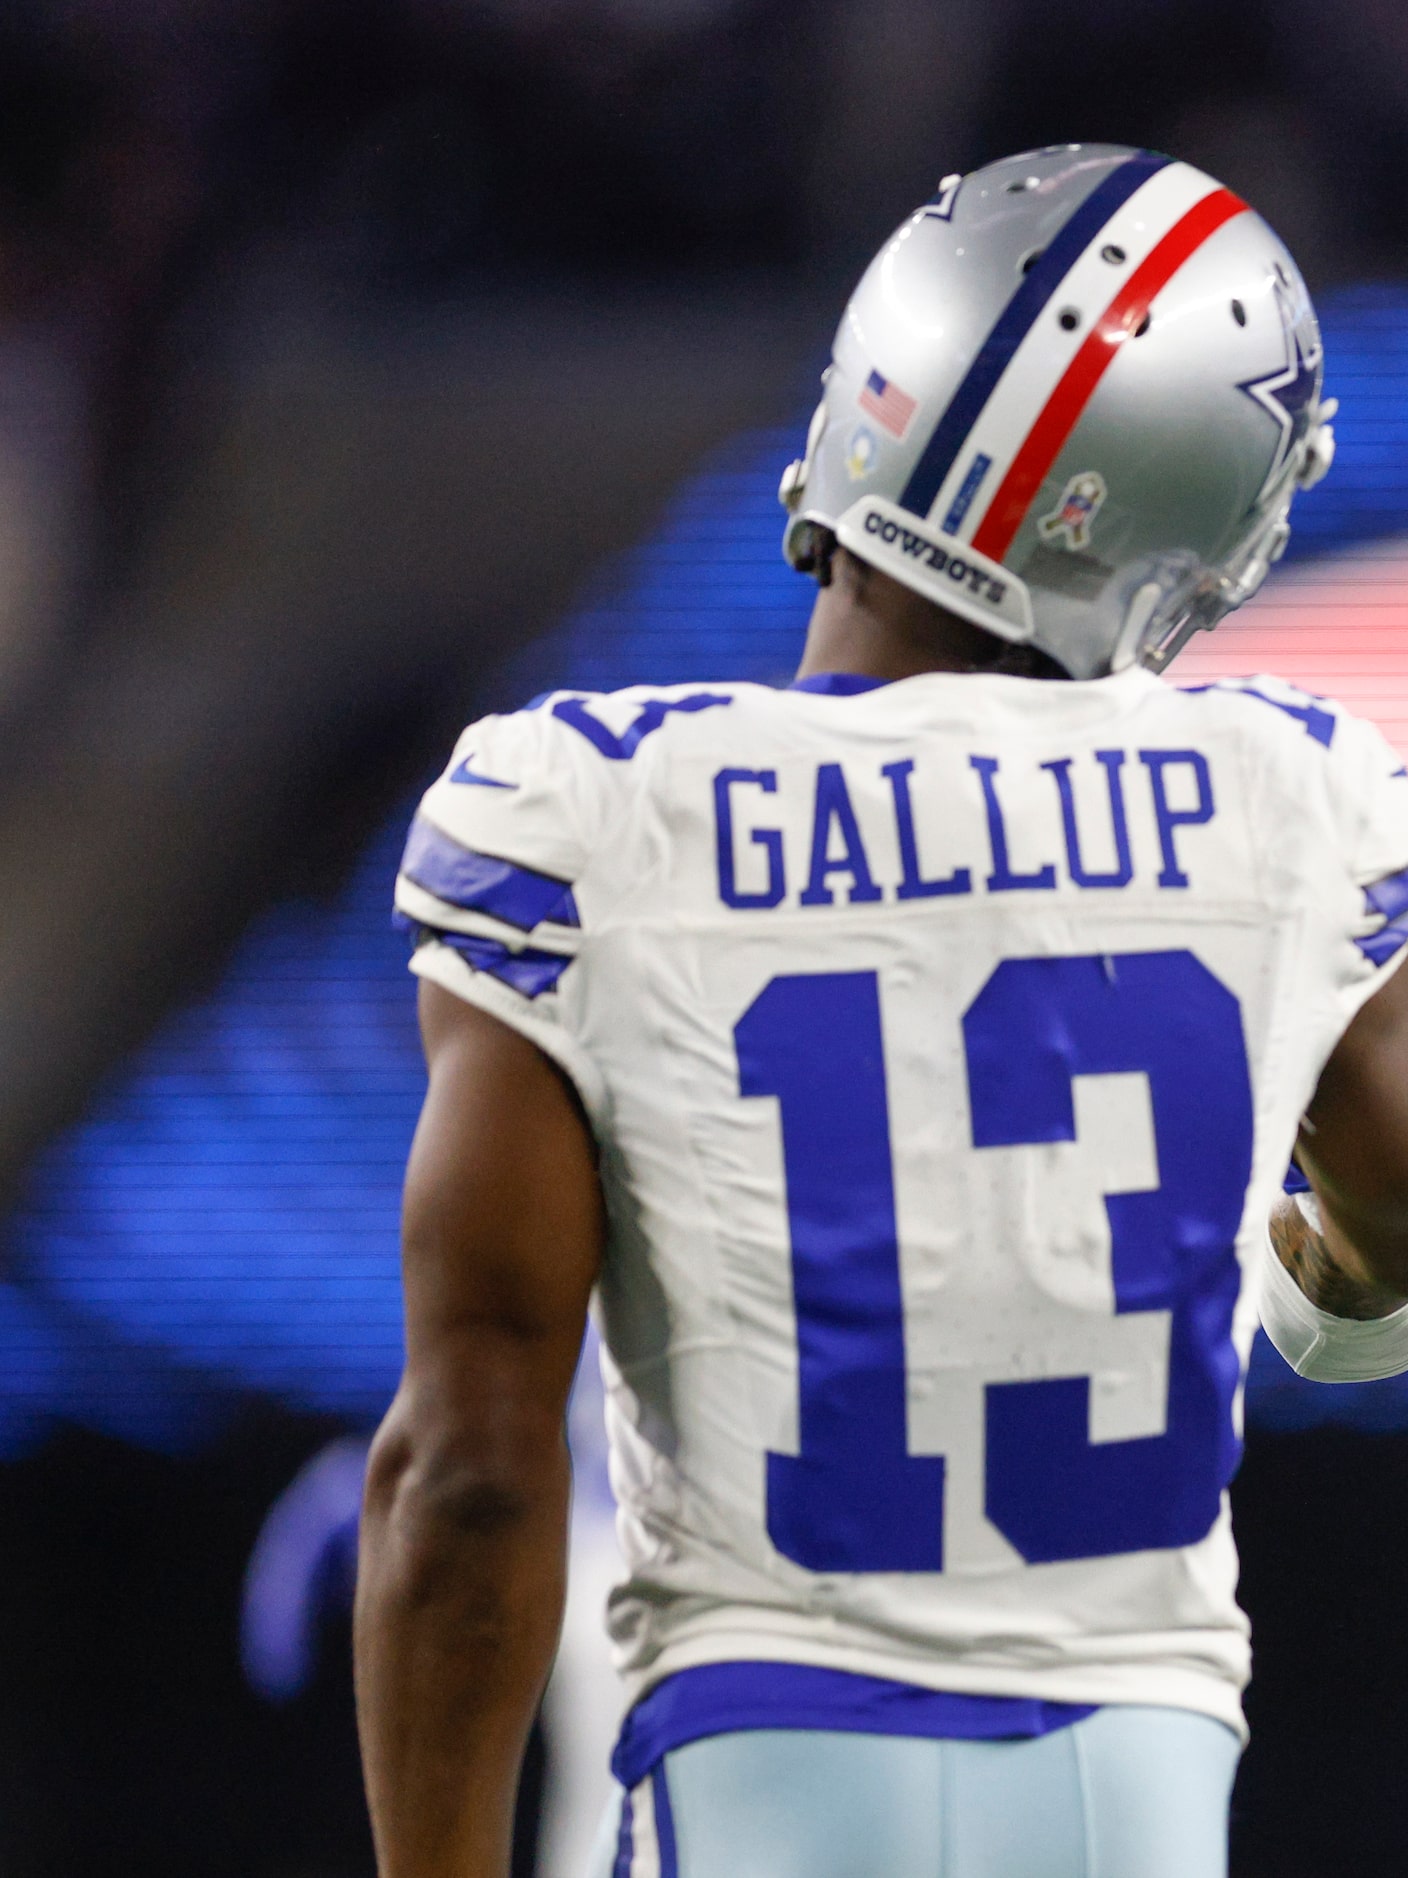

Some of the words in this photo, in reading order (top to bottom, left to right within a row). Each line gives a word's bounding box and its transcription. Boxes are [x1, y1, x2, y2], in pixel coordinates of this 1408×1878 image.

[863, 511, 1007, 604] COWBOYS
[713, 749, 1215, 909] GALLUP
[733, 948, 1255, 1573] 13
